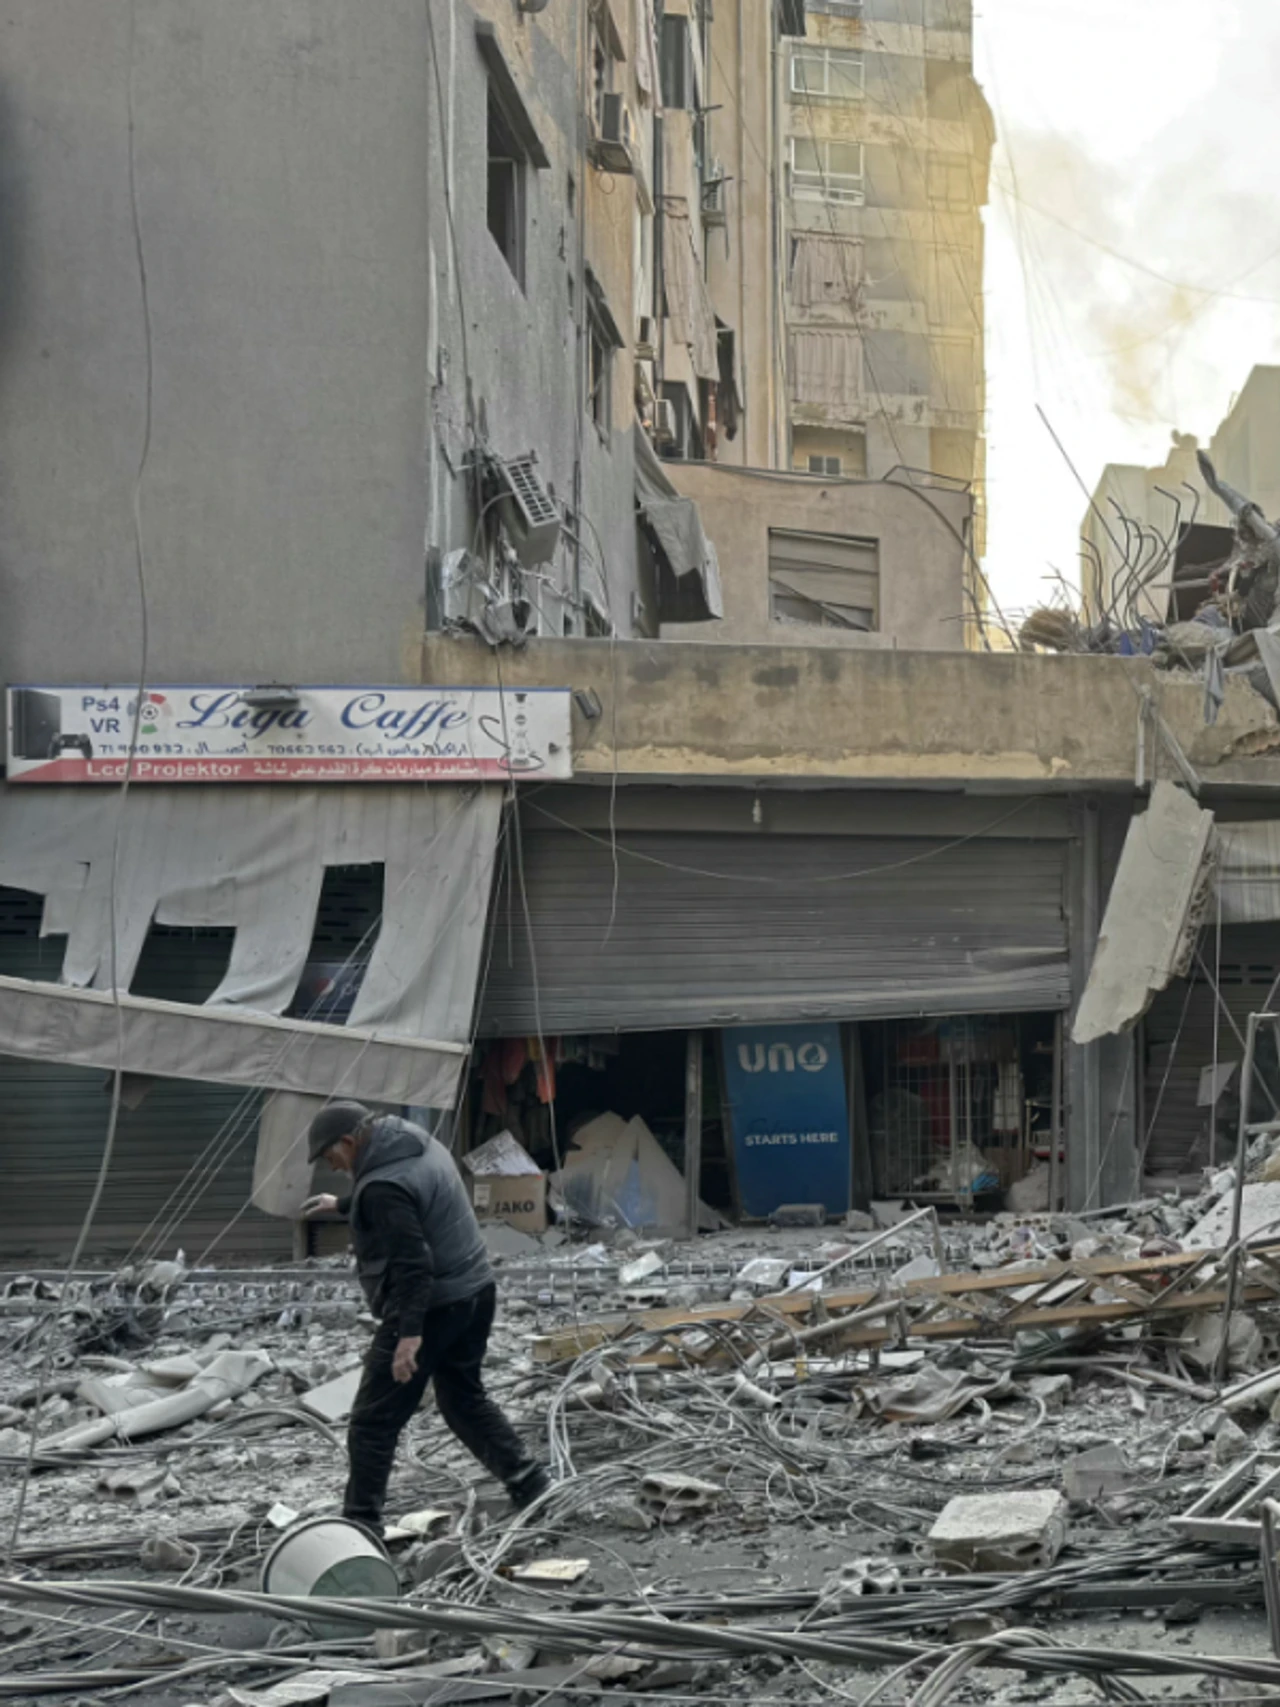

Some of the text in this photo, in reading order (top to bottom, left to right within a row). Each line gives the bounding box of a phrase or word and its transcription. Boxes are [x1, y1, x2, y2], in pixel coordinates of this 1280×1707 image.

[340, 693, 472, 740] Caffe
[90, 718, 121, 733] VR
[86, 761, 242, 778] Lcd Projektor
[253, 761, 288, 775] شاشة
[318, 761, 351, 777] القدم
[352, 762, 382, 778] كرة
[385, 762, 432, 777] مباريات
[434, 761, 479, 776] مشاهدة
[744, 1132, 839, 1147] STARTS HERE
